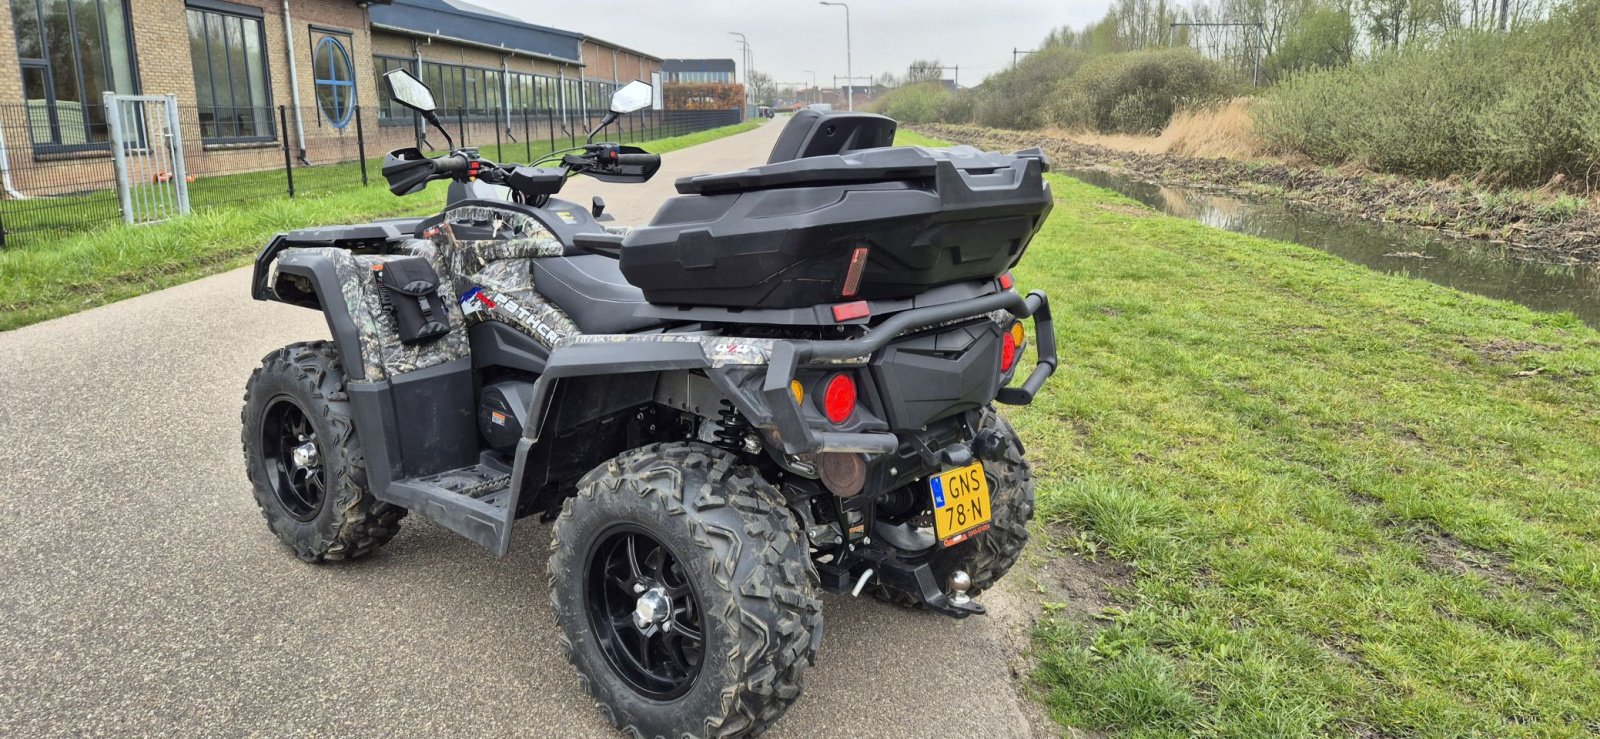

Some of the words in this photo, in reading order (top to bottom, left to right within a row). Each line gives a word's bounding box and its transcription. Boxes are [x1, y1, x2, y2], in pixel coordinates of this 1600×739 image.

[493, 292, 560, 346] PATHCR
[949, 469, 980, 498] GNS
[945, 497, 982, 531] 78-N
